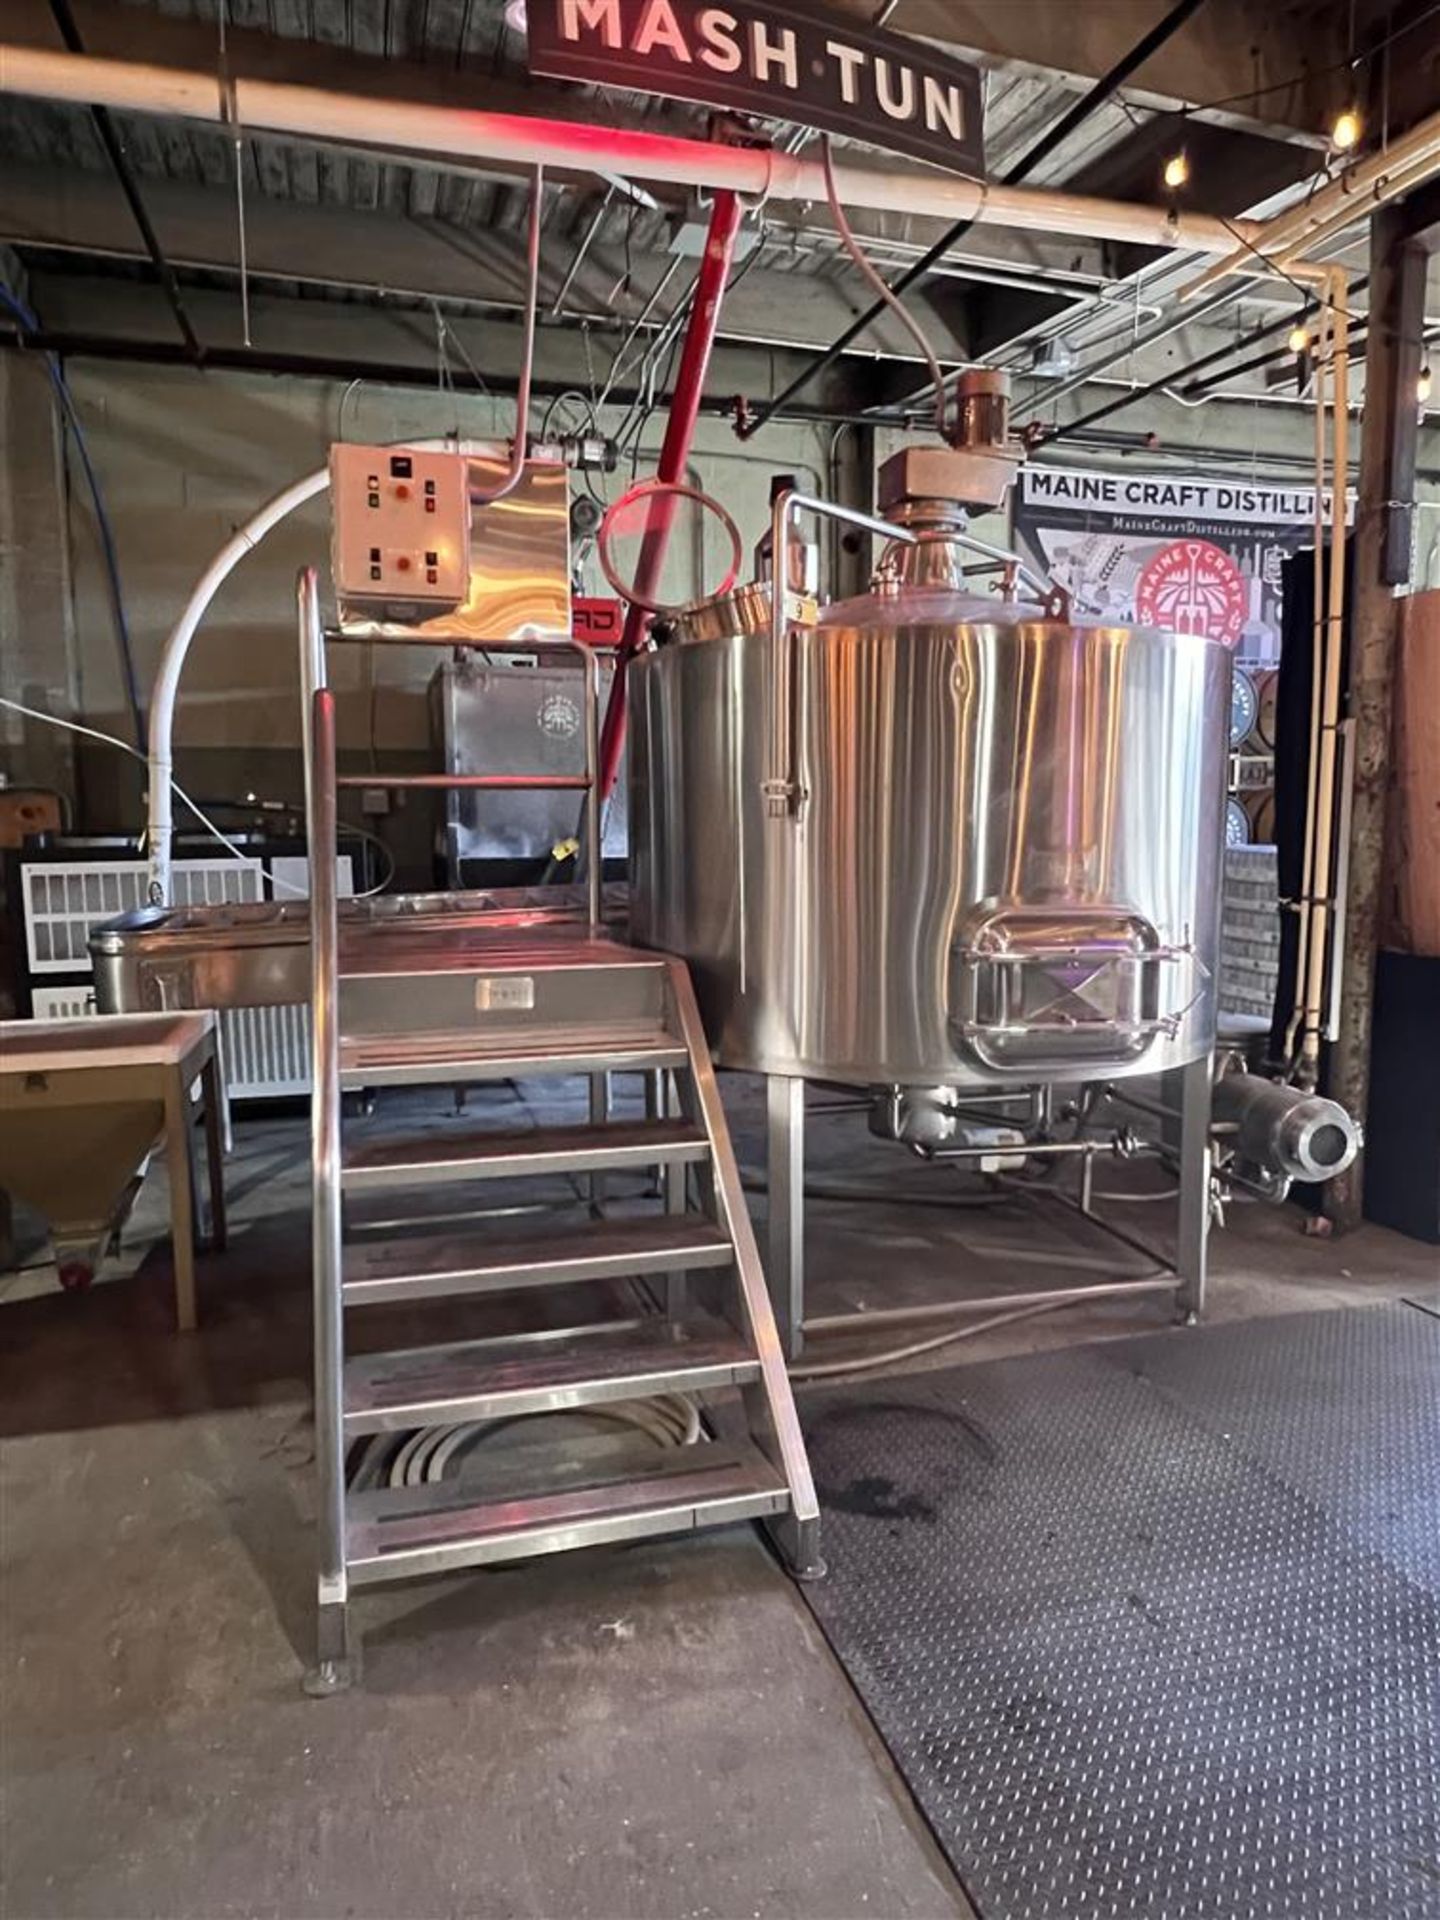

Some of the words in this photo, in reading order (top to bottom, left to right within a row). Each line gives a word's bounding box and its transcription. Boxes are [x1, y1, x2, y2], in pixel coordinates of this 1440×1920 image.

[559, 0, 798, 88] MASH
[826, 41, 965, 141] TUN
[1031, 473, 1117, 501] MAINE
[1125, 482, 1209, 507] CRAFT
[1217, 488, 1348, 515] DISTILLIN
[1142, 548, 1183, 599] MAINE
[1204, 550, 1242, 604] CRAFT
